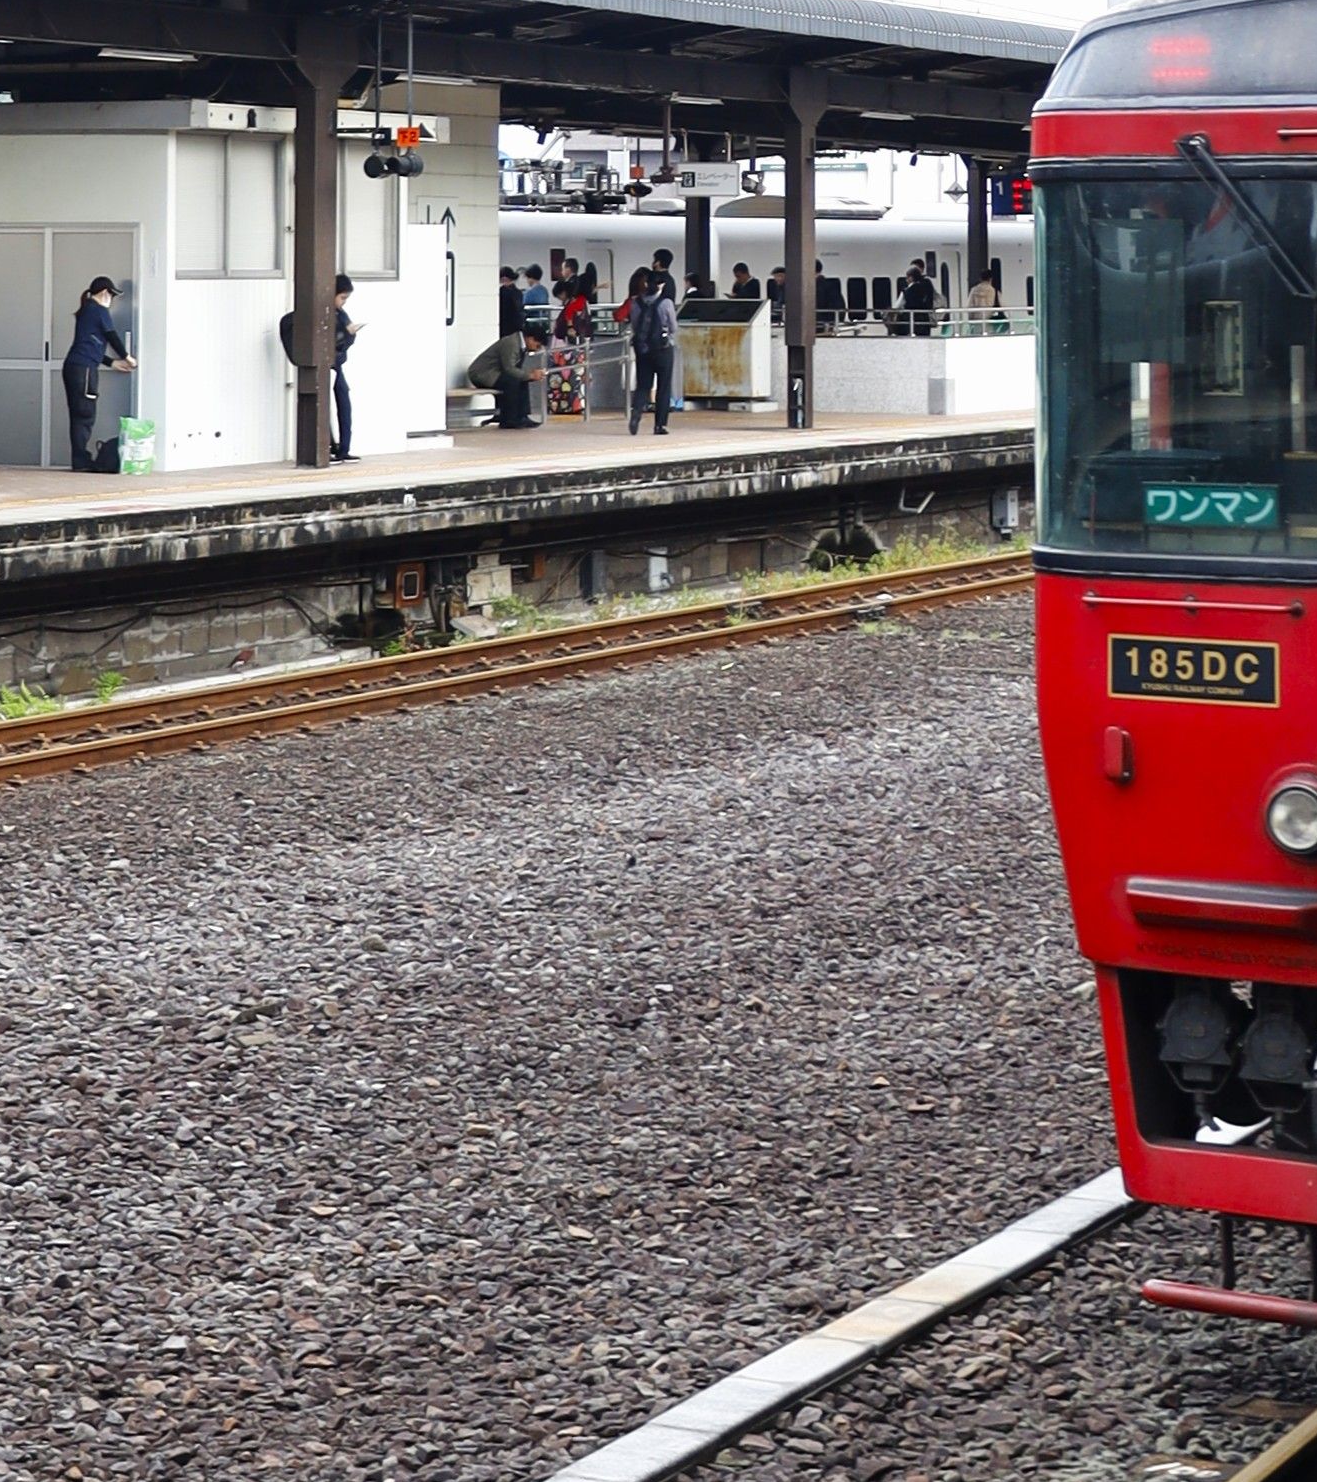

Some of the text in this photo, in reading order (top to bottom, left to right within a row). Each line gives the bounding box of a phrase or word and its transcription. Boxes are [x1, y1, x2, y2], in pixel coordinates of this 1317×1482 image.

[1146, 489, 1275, 524] ワンマン
[1125, 646, 1260, 685] 185DC
